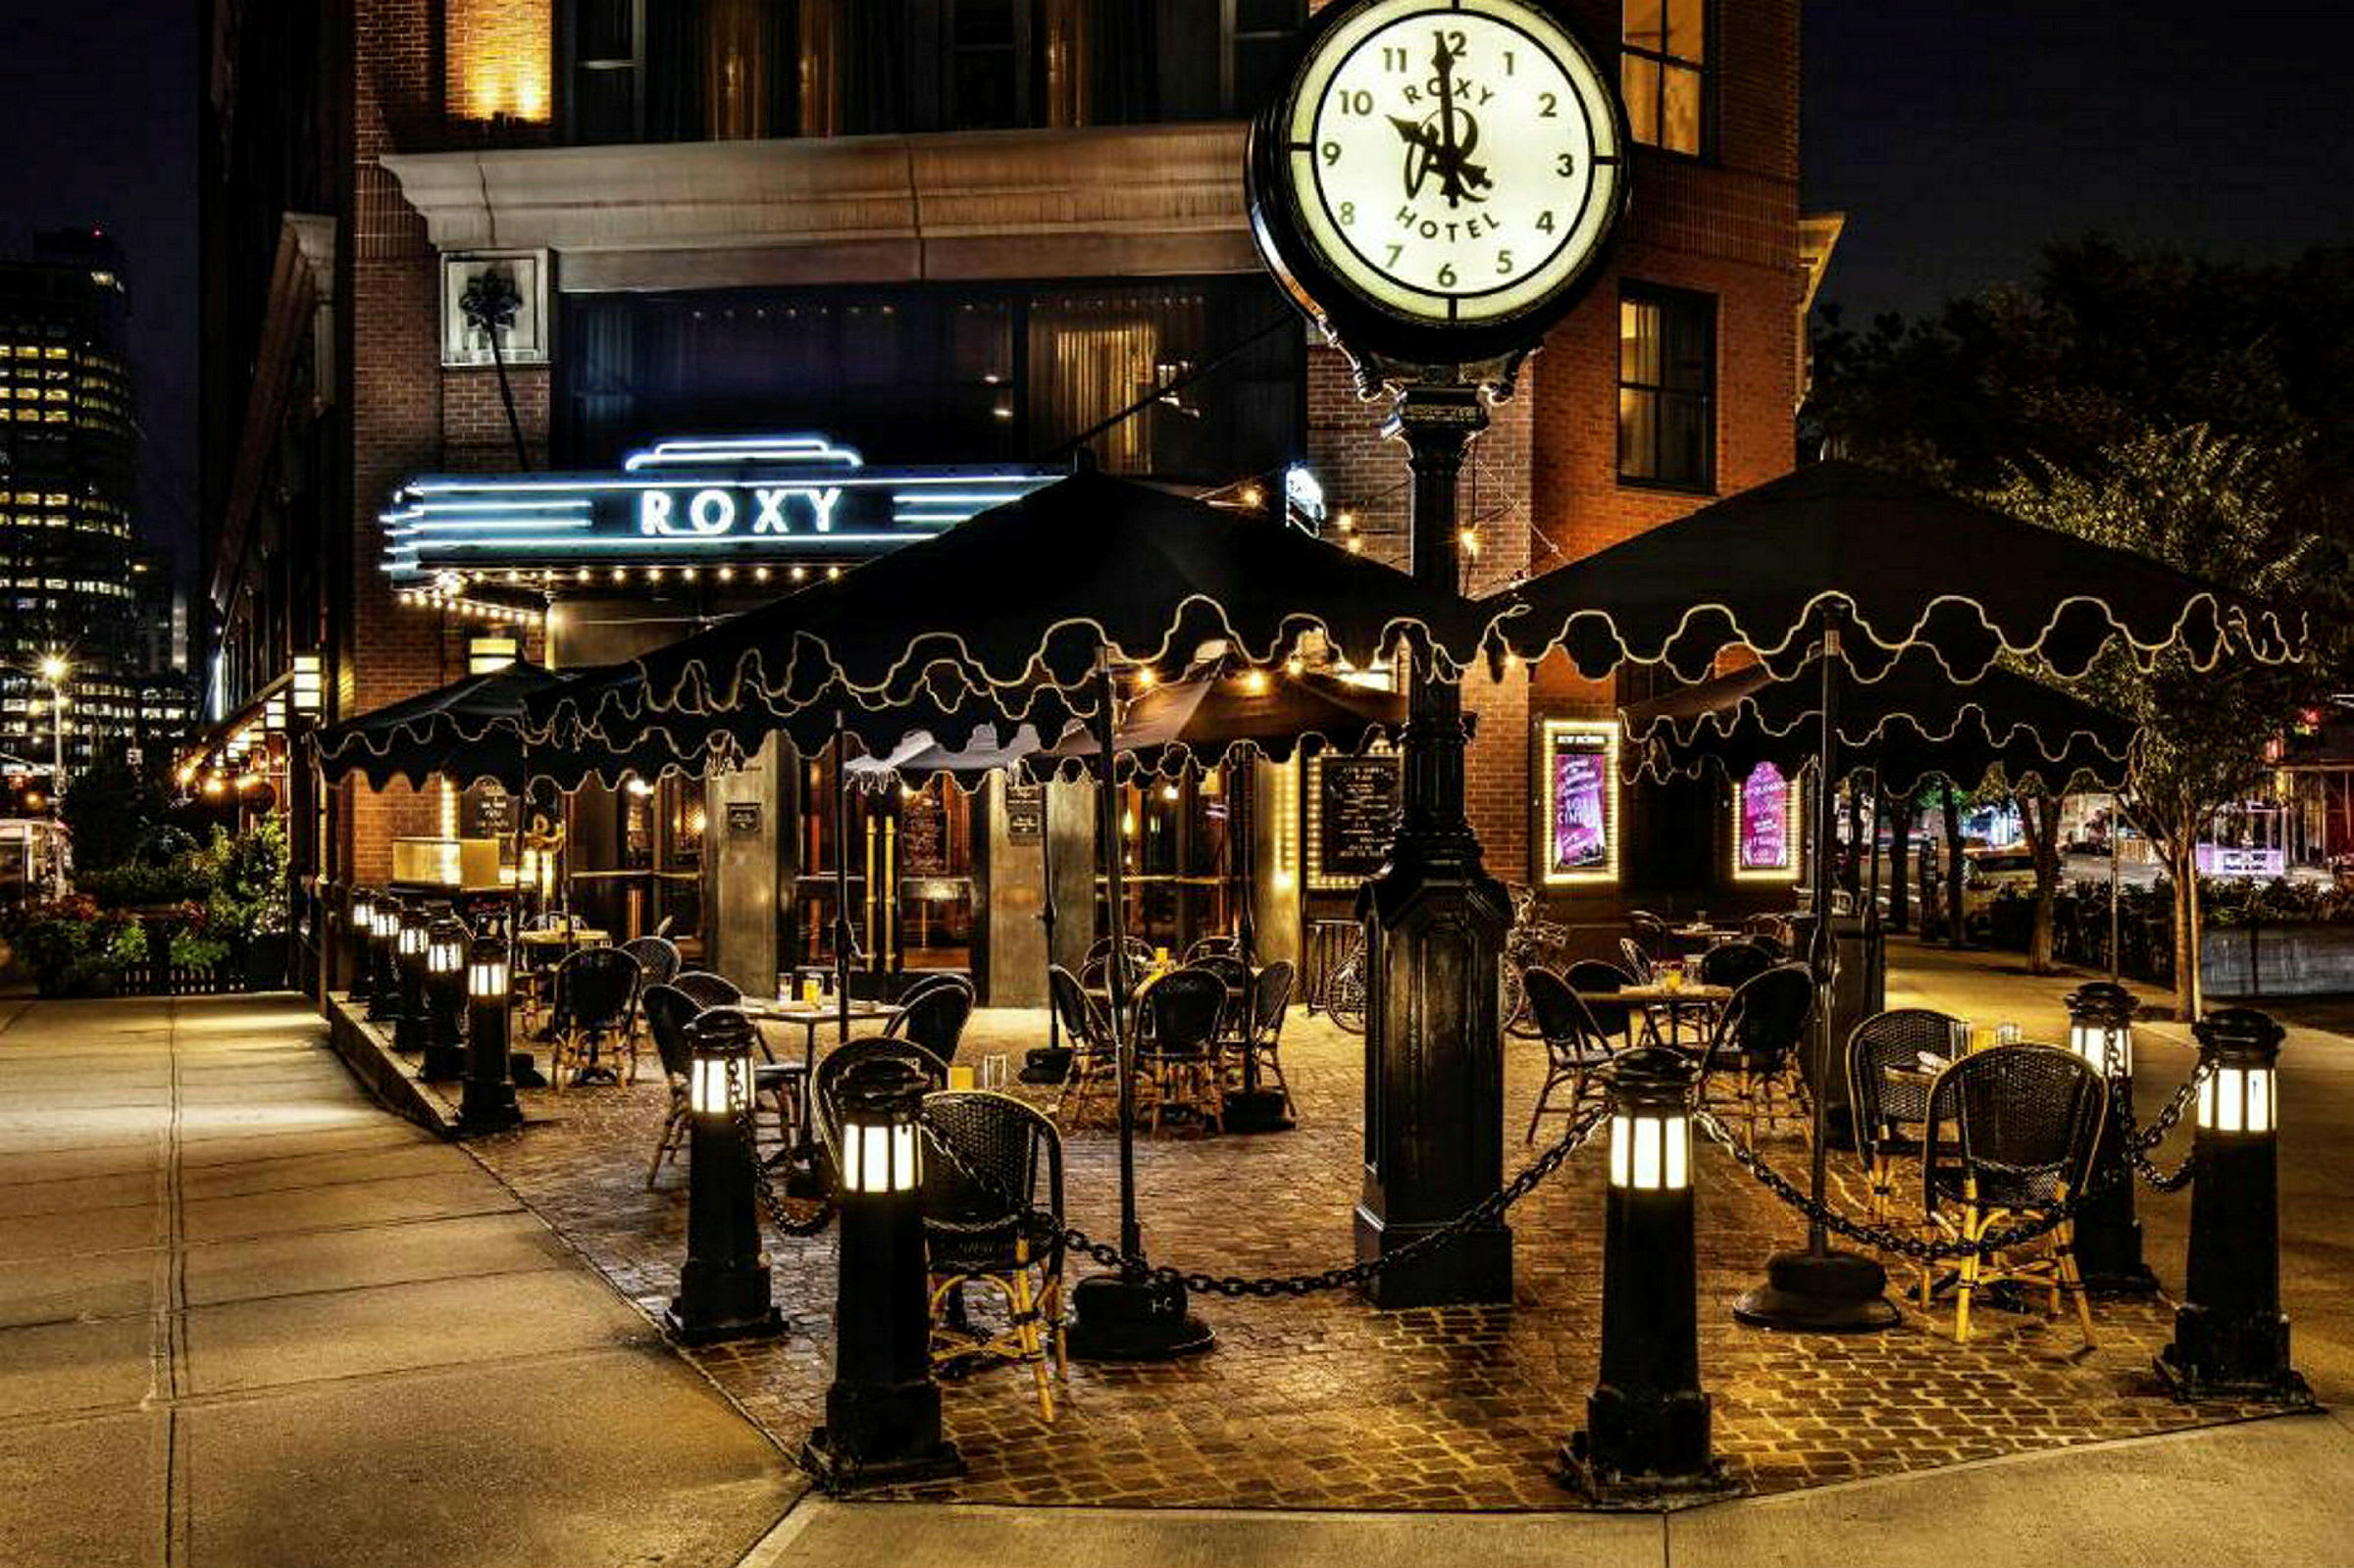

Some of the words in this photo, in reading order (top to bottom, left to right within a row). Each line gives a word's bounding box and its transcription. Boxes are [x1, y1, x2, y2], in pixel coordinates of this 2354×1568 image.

[1433, 30, 1467, 57] 12
[1383, 47, 1407, 73] 11
[1503, 51, 1513, 76] 1
[1339, 90, 1373, 117] 10
[1403, 76, 1496, 106] ROXY
[1539, 92, 1558, 119] 2
[1322, 141, 1343, 167] 9
[1557, 153, 1575, 178] 3
[1340, 201, 1356, 227] 8
[1396, 204, 1501, 243] HOTEL
[1535, 210, 1556, 235] 4
[1385, 244, 1404, 270] 7
[1496, 250, 1513, 276] 5
[1437, 263, 1458, 288] 6
[640, 487, 843, 536] ROXY
